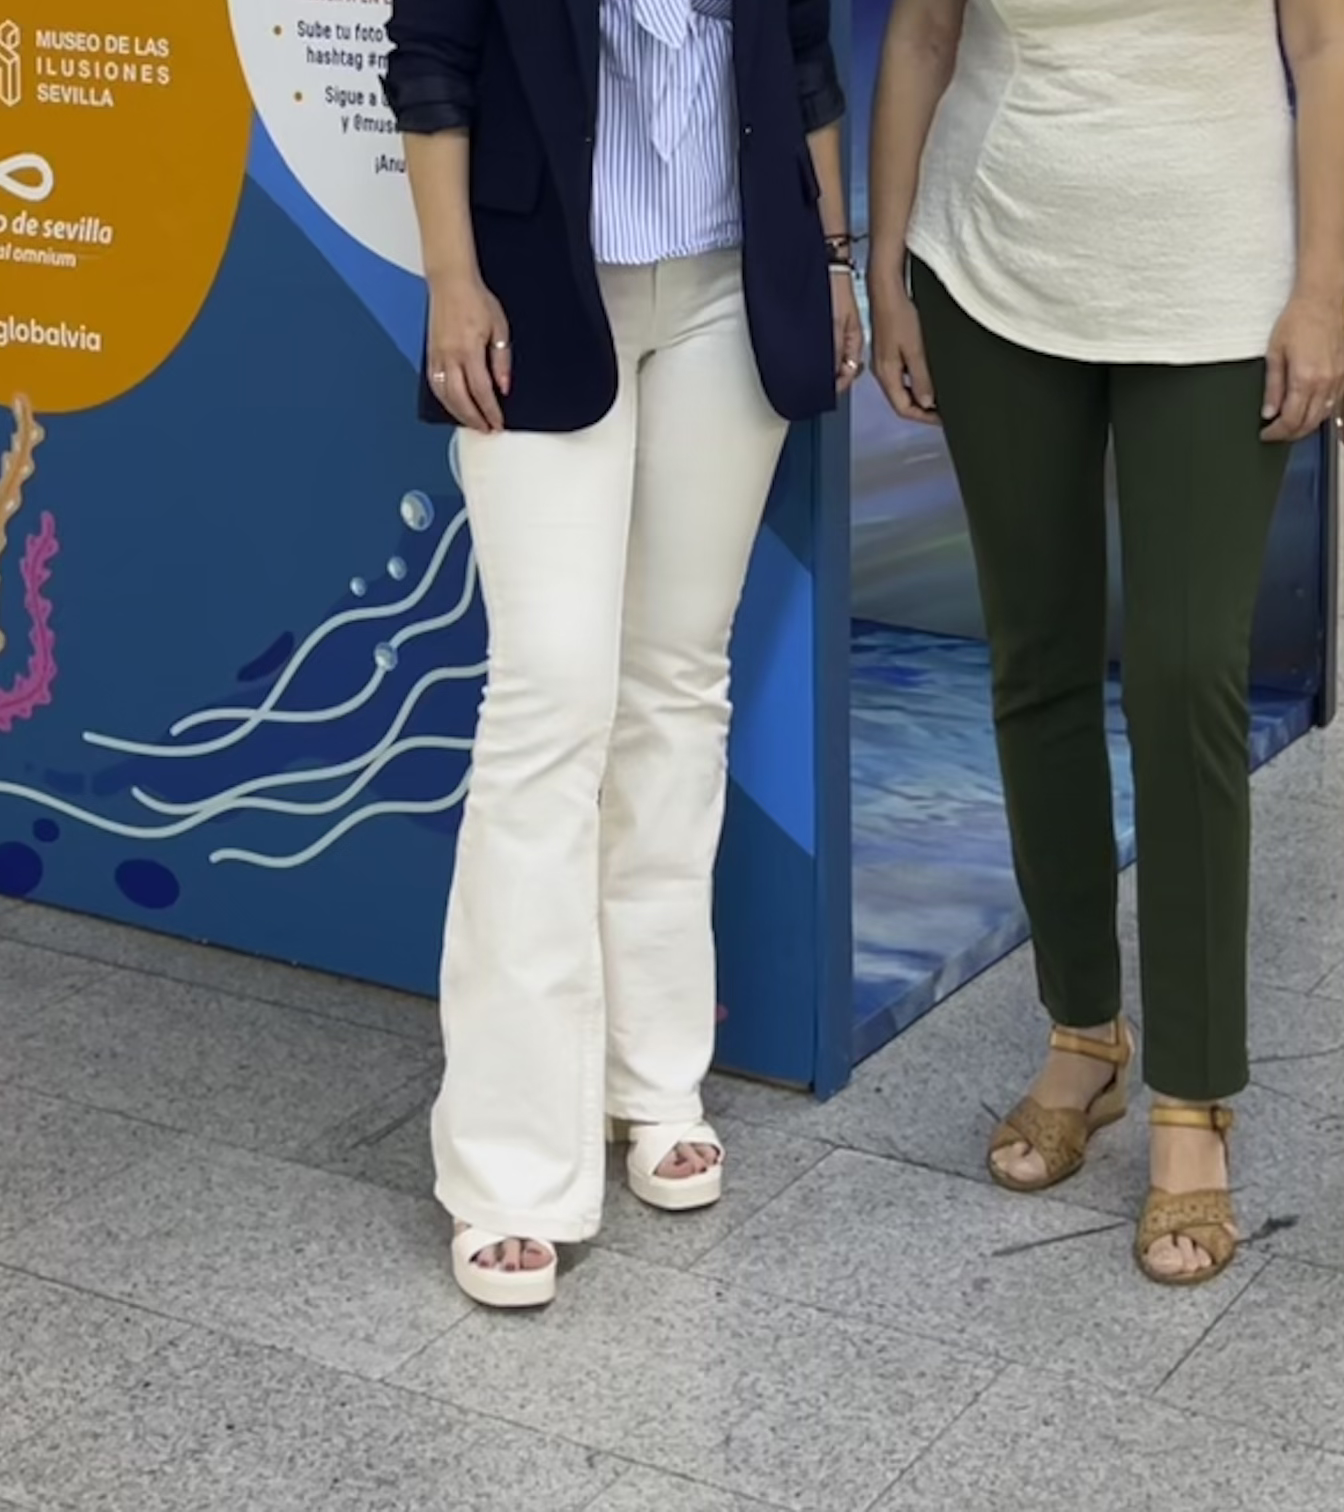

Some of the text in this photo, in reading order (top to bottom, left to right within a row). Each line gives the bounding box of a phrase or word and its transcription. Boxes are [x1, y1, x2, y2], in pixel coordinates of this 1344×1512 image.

[297, 19, 384, 43] Sube tu foto
[35, 30, 170, 59] MUSEO DE LAS
[35, 57, 171, 85] ILUSIONES
[306, 46, 364, 72] hashtag
[36, 83, 115, 108] SEVILLA
[325, 85, 364, 109] Sigue
[369, 92, 377, 105] a
[340, 116, 349, 135] y
[12, 209, 39, 236] de
[42, 216, 114, 245] sevilla
[12, 247, 78, 268] omnium
